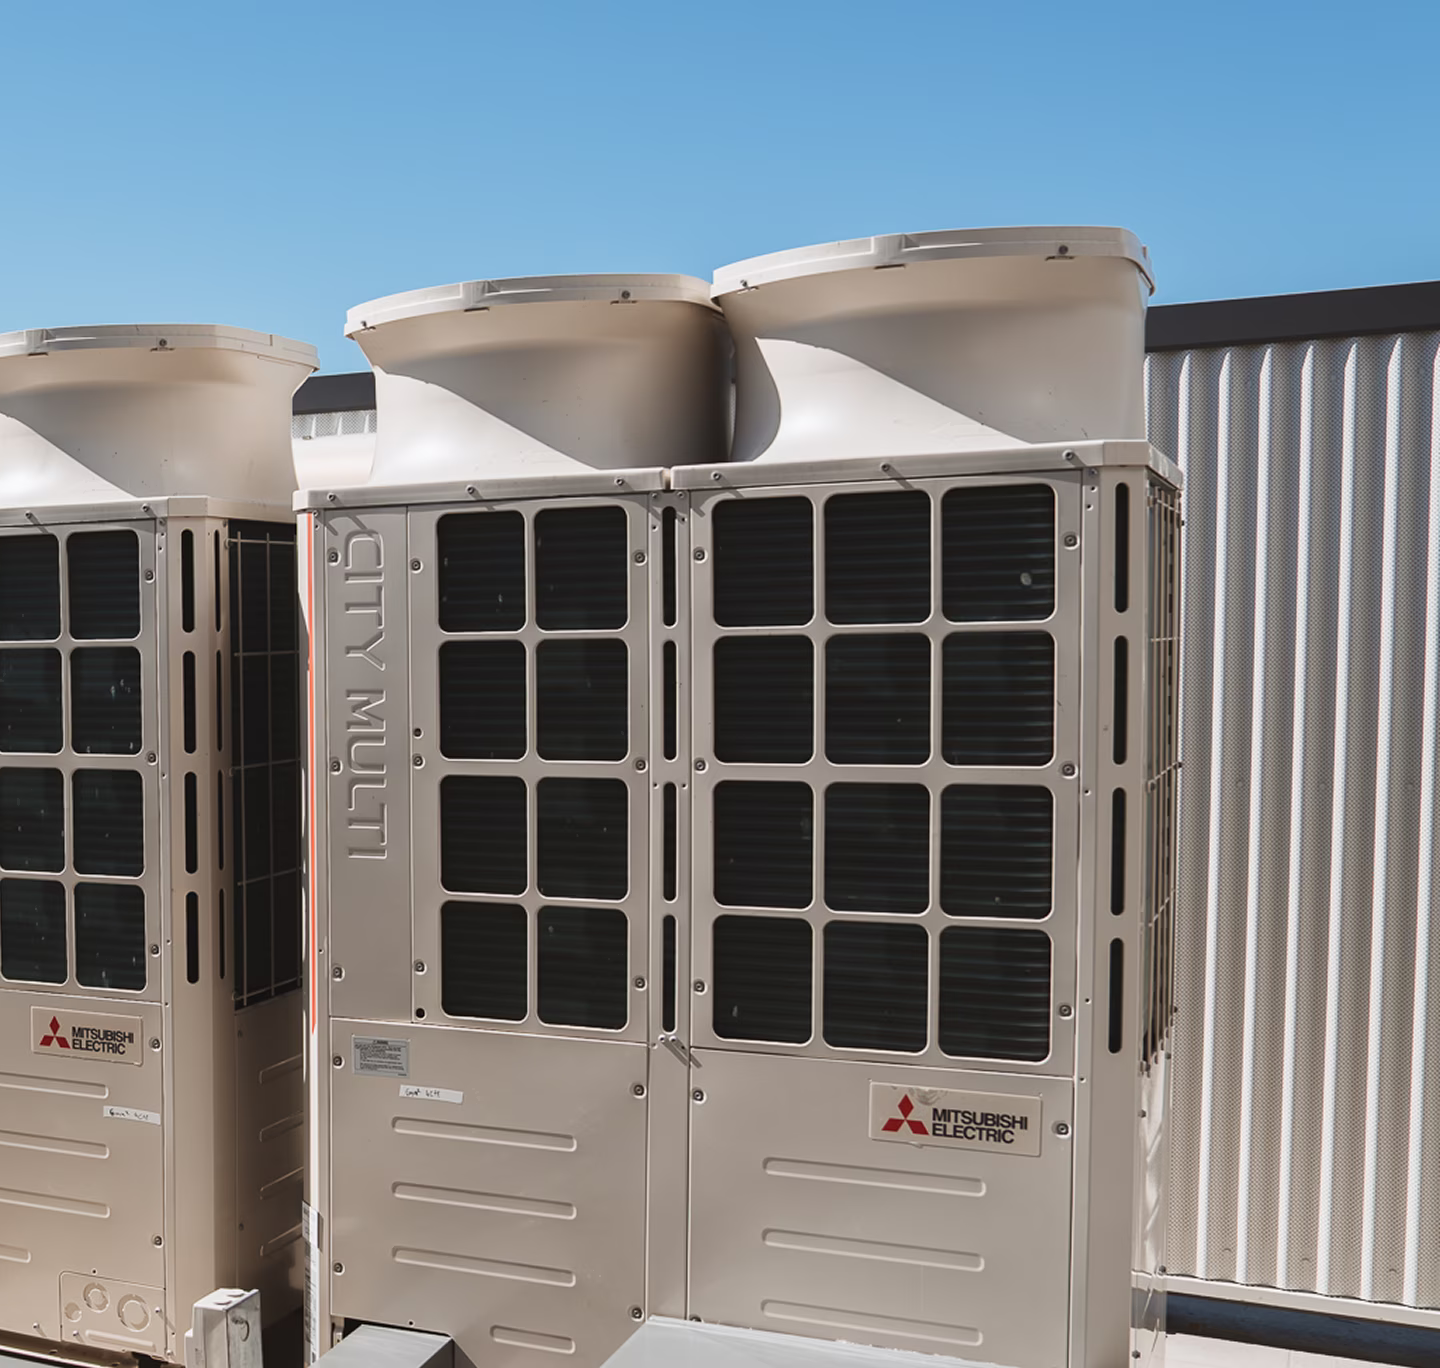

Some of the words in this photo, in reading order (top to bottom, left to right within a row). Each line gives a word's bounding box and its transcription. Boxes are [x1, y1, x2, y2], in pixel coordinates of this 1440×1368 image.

[344, 530, 386, 671] CITY
[346, 689, 388, 860] MULTI
[71, 1026, 134, 1044] MITSUBISHI
[71, 1038, 126, 1055] ELECTRIC
[932, 1107, 1028, 1130] MITSUBISHI
[932, 1123, 1015, 1144] ELECTRIC
